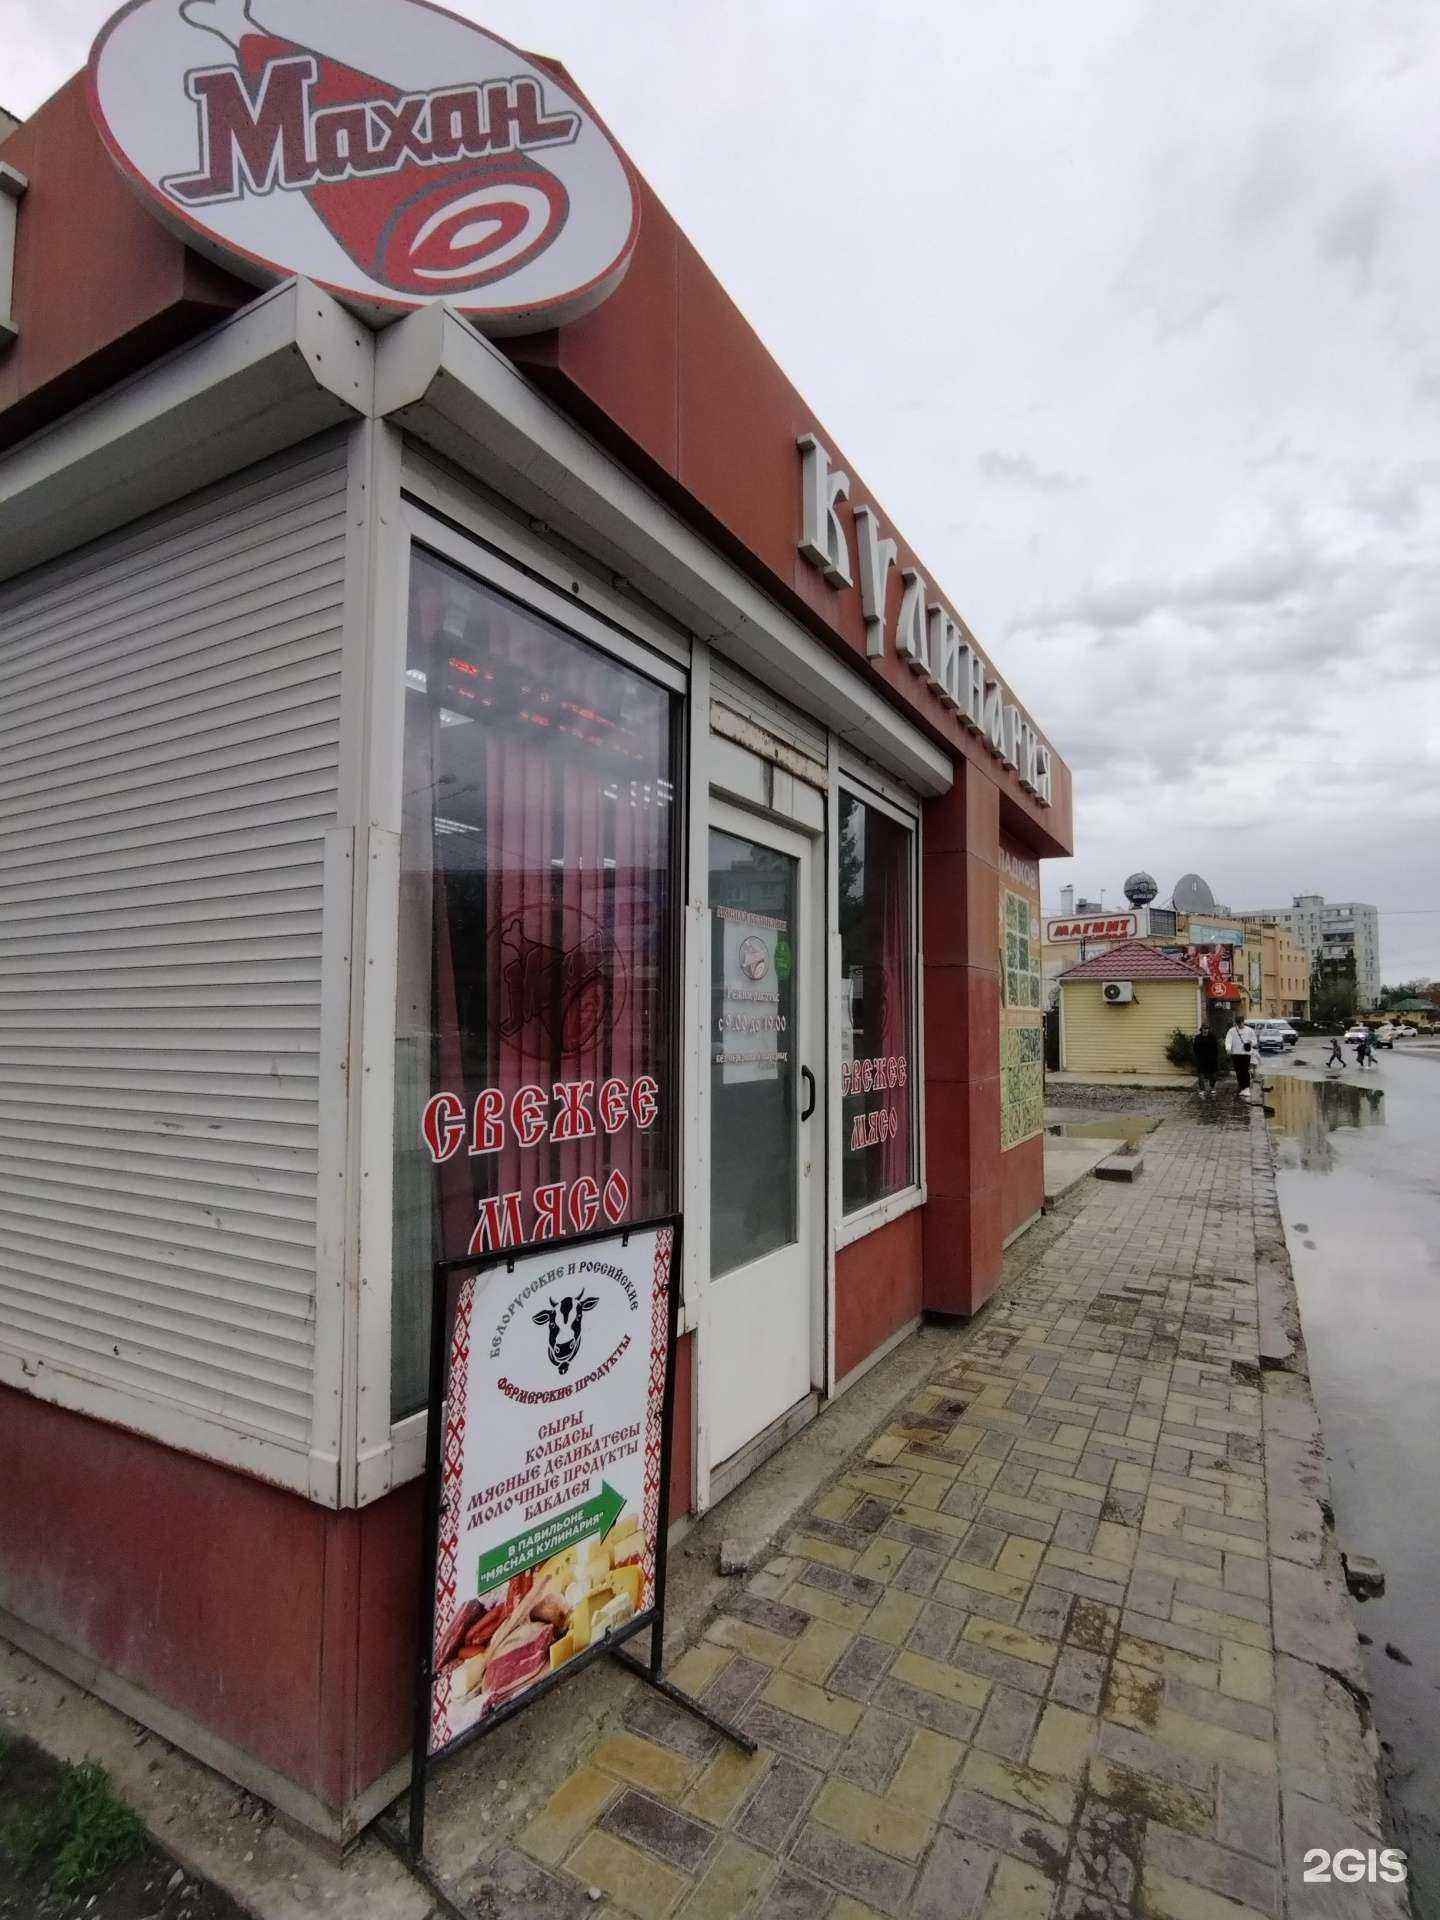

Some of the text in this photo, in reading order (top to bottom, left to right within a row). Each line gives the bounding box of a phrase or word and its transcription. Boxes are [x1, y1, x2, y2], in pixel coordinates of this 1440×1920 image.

[159, 54, 582, 207] Махан
[797, 432, 1052, 808] КУЛИНАРИЯ
[1053, 919, 1130, 937] МАГНИТ
[841, 1056, 907, 1097] СВЕЖЕЕ
[421, 1075, 660, 1164] СВЕЖЕЕ
[851, 1106, 898, 1151] МЯСО
[467, 1168, 630, 1256] МЯСО
[490, 1260, 640, 1360] БЕЛОРУССКИЕ И РОССИЙСКИЕ
[497, 1333, 632, 1405] ФЕРМЕРСКИЕ ПРОДУКТЫ
[525, 1424, 594, 1465] КОЛБАСЫ
[537, 1410, 584, 1441] СЫРЫ
[466, 1422, 641, 1512] МЯСНЫЕ ДЕЛИКАТЕСЫ
[467, 1439, 639, 1532] МОЛОЧНЫЕ ПРОДУКТЫ
[523, 1478, 591, 1522] БАКАЛЕЯ
[480, 1511, 604, 1582] "МЯСНАЯ КУЛИНАРИЯ"
[508, 1509, 585, 1558] В ПАВИЛЬОНЕ
